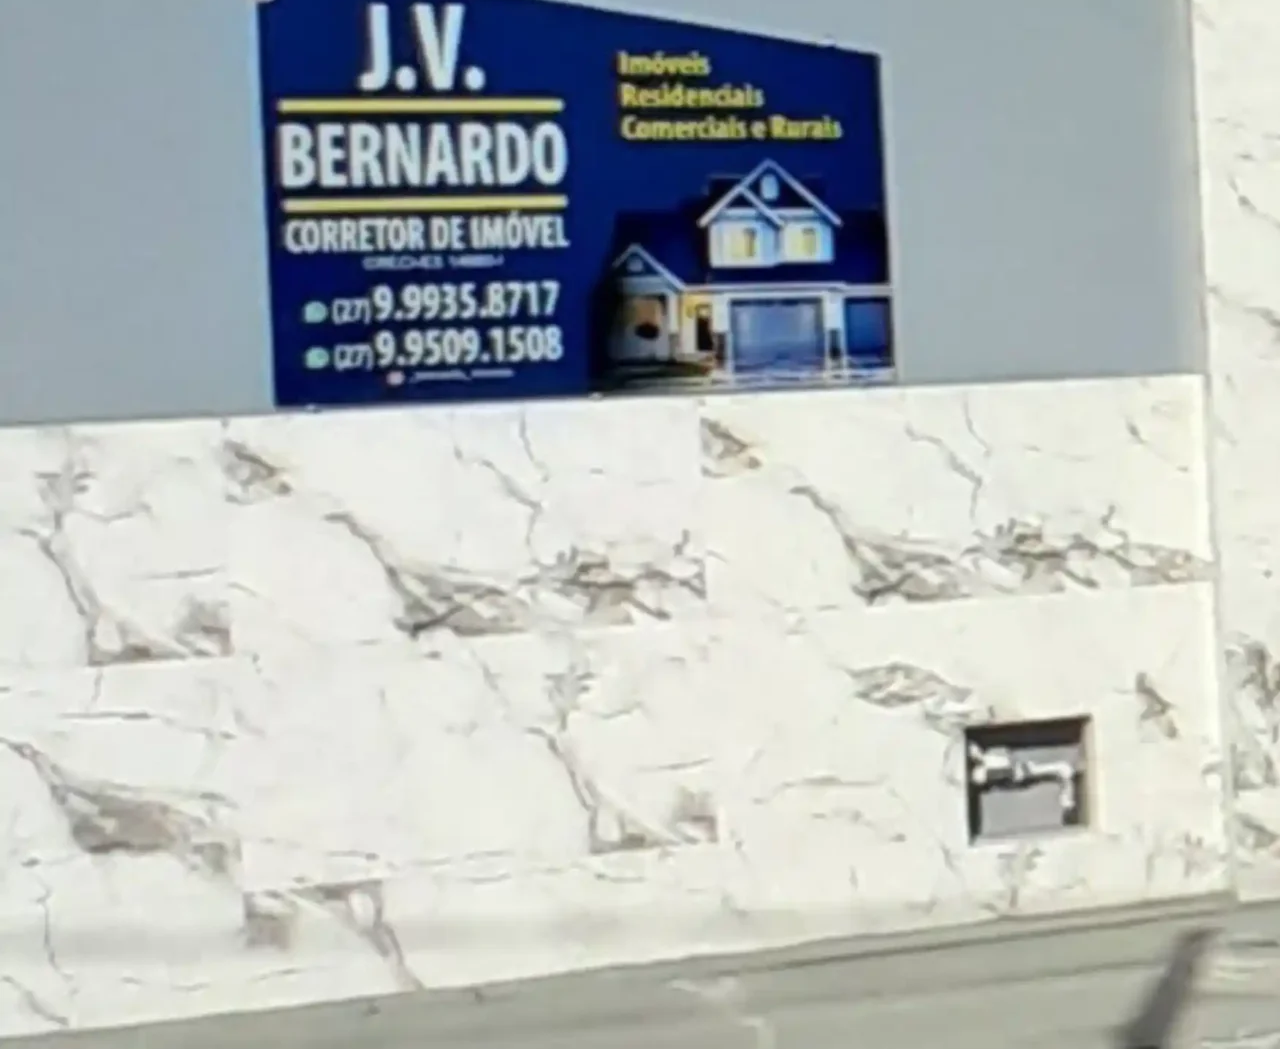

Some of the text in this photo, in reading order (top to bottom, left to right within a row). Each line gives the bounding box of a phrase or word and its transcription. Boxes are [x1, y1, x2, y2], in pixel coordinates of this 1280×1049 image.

[358, 2, 486, 91] J.V.
[617, 50, 711, 75] Imóveis
[618, 82, 765, 108] Residenciais
[620, 114, 843, 141] Comerciais e Rurais
[277, 121, 568, 189] BERNARDO
[284, 210, 570, 253] CORRETOR DE IMÓVEL
